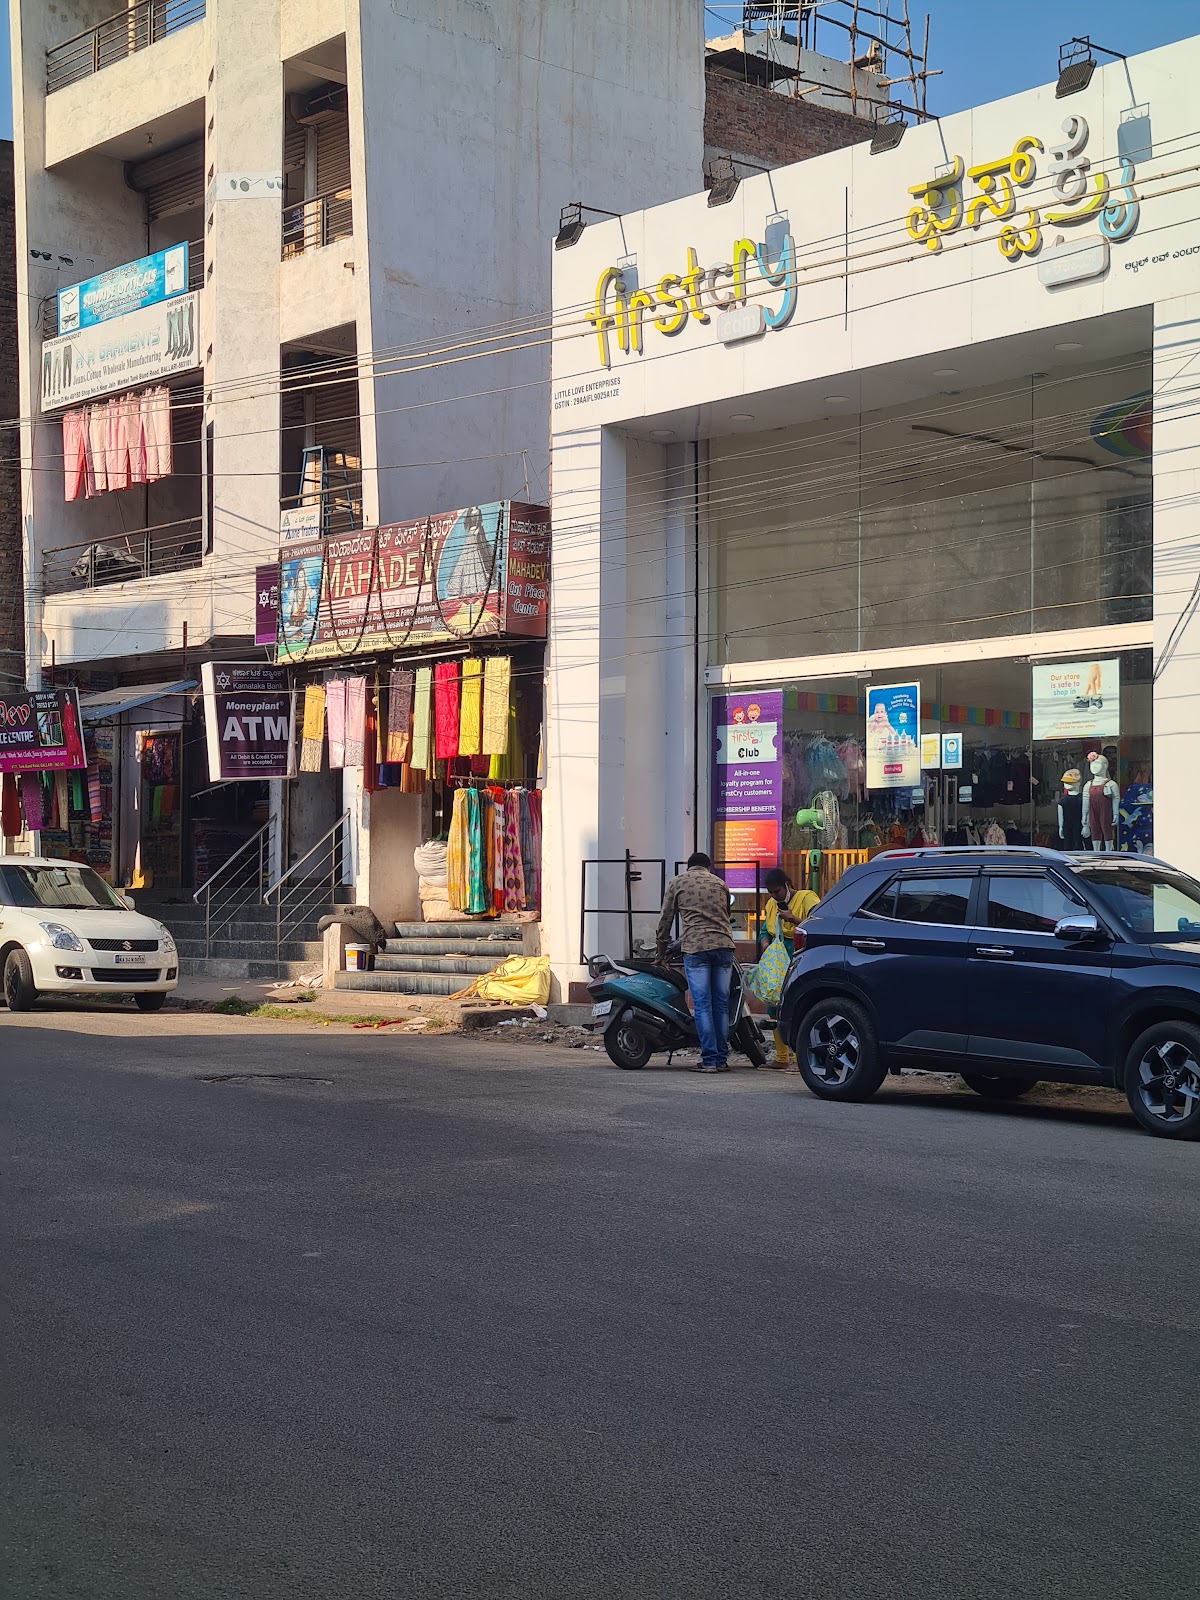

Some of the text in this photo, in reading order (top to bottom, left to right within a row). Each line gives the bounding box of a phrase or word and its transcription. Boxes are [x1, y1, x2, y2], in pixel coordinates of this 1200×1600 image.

[1152, 252, 1169, 264] ಲವ್
[117, 269, 157, 296] OPTICALS
[585, 233, 797, 368] firstcry
[127, 350, 161, 370] Manufacturing
[554, 377, 621, 400] LITTLE LOVE ENTERPRISES
[554, 400, 570, 410] GSTIN
[301, 524, 319, 538] Traders
[321, 540, 439, 600] MAHADEV
[509, 557, 546, 580] MAHADEV
[508, 580, 545, 600] Cut Piece
[513, 599, 539, 615] Centre
[233, 682, 284, 690] Karnataka Bank
[1057, 680, 1072, 688] safe
[1053, 689, 1069, 697] shop
[223, 716, 289, 741] ATM
[732, 729, 764, 744] firstcry
[738, 747, 759, 758] Club
[734, 769, 760, 777] All-in-one
[720, 780, 739, 788] loyalty
[740, 779, 764, 788] program
[744, 788, 772, 796] customers
